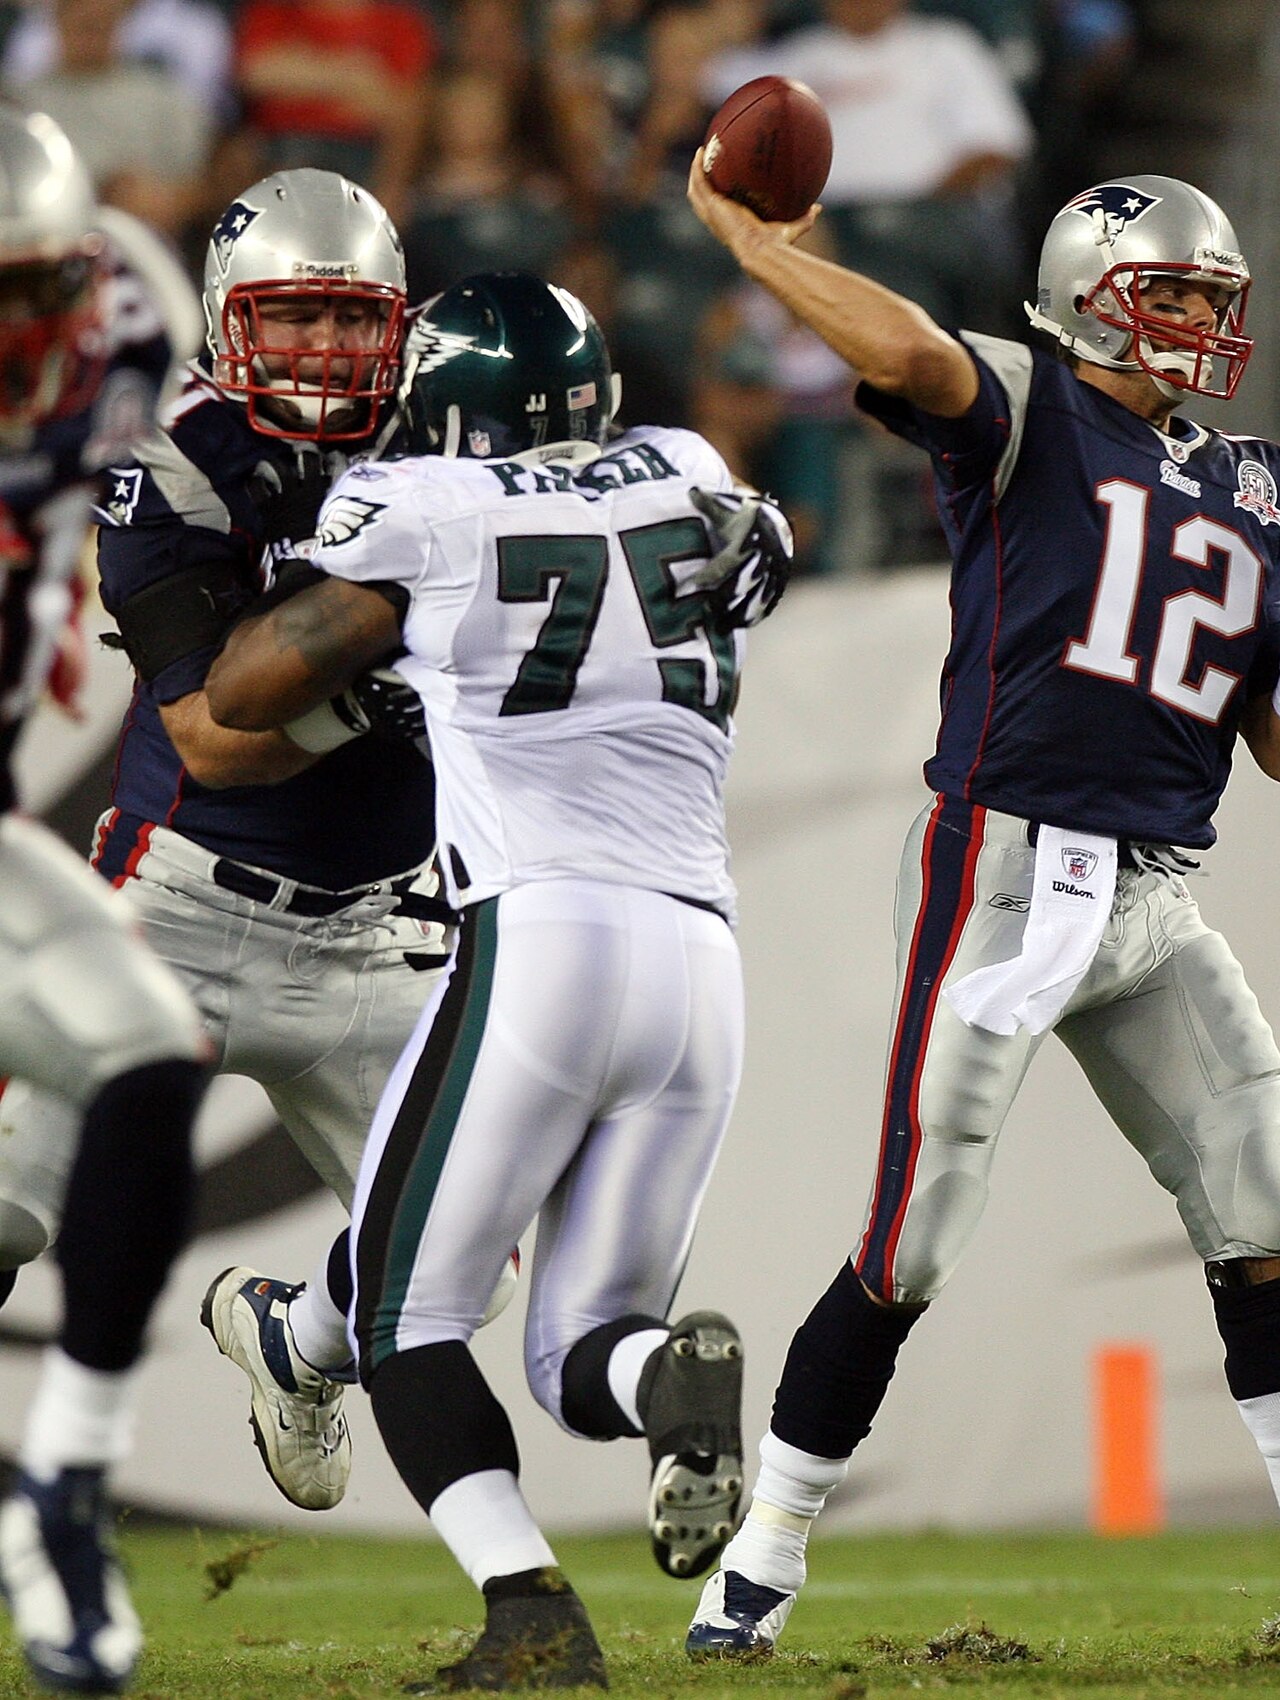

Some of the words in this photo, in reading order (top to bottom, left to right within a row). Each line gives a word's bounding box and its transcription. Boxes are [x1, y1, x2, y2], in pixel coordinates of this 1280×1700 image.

[525, 393, 547, 412] JJ
[496, 517, 738, 738] 75
[1060, 477, 1264, 726] 12
[1052, 881, 1096, 899] Wilson
